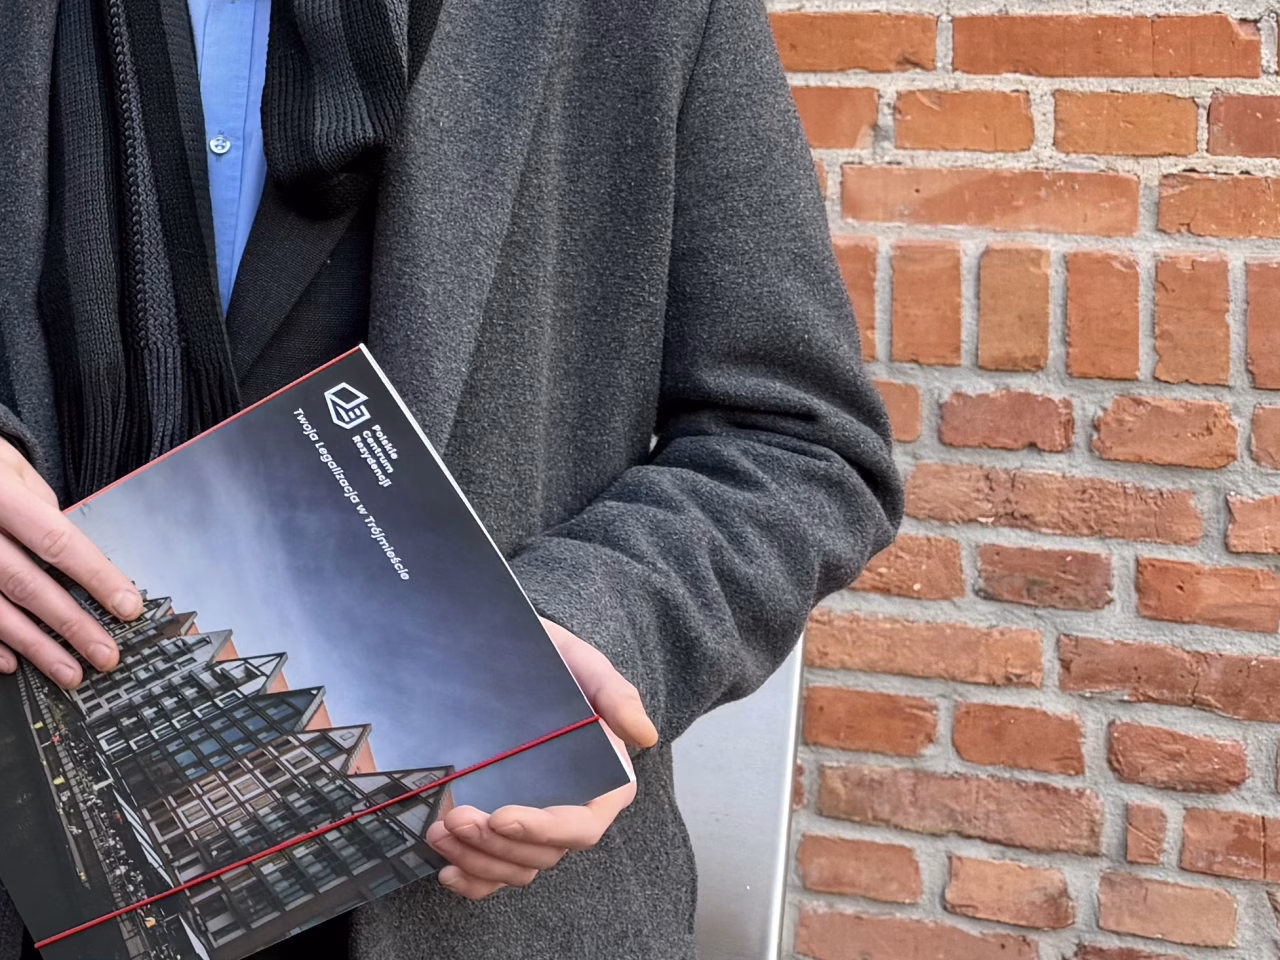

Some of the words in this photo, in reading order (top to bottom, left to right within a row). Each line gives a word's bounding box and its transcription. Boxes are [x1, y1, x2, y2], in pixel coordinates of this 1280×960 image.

[352, 434, 393, 488] Rezydencji
[362, 430, 394, 474] Centrum
[371, 424, 398, 460] Polskie
[293, 407, 320, 442] Twoja
[314, 441, 360, 504] Legalizacja
[356, 504, 369, 515] w
[364, 515, 410, 580] Trójmieście
